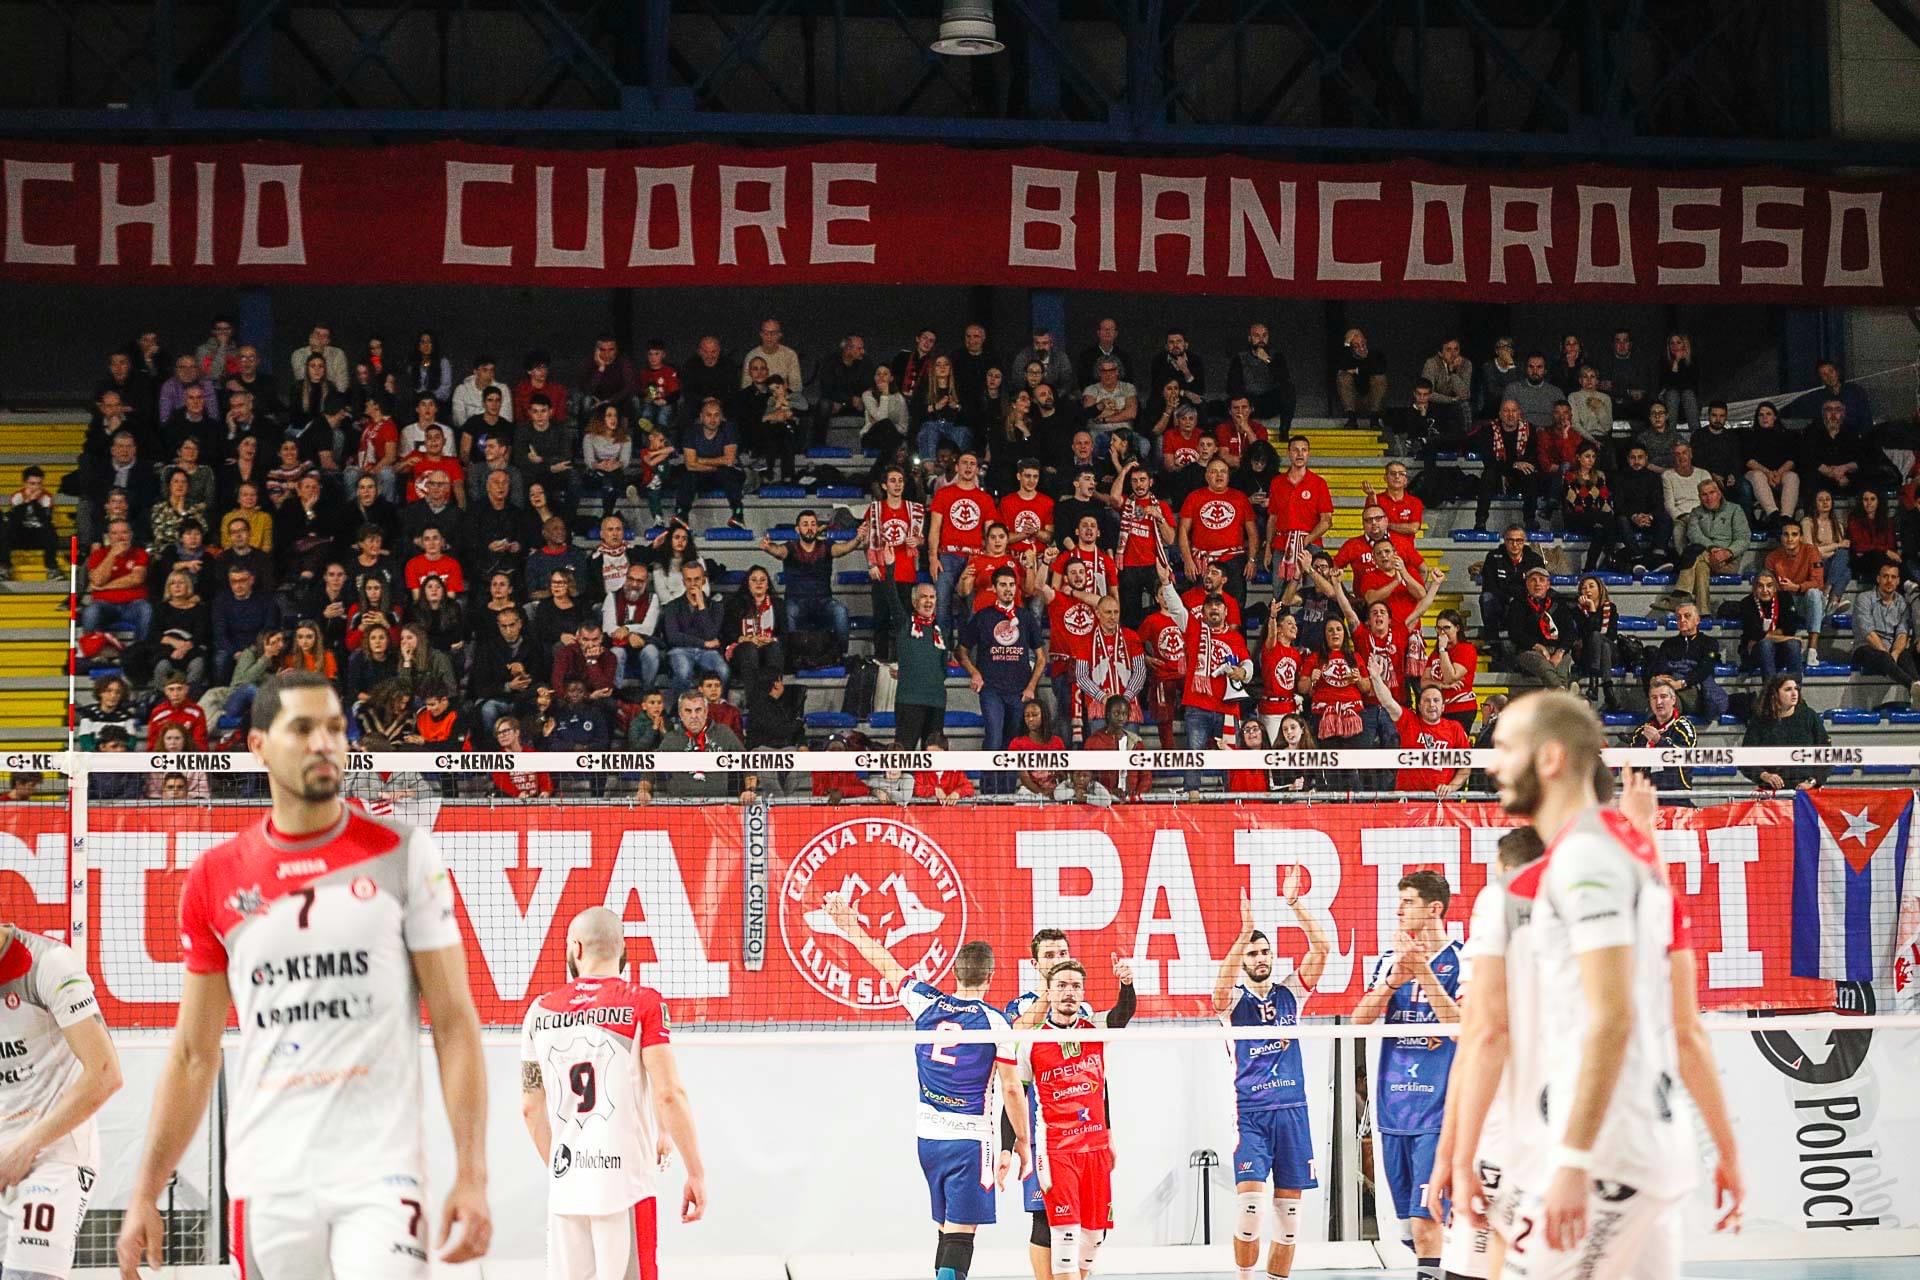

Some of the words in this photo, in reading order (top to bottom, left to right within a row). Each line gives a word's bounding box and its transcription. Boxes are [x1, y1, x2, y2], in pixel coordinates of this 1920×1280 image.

[3, 155, 307, 266] CHIO
[441, 160, 878, 269] CUORE
[1007, 164, 1884, 289] BIANCOROSSO
[176, 754, 230, 770] KEMAS
[459, 754, 515, 770] KEMAS
[601, 754, 655, 770] KEMAS
[741, 753, 795, 769] KEMAS
[879, 753, 932, 768] KEMAS
[1017, 752, 1069, 768] KEMAS
[1152, 752, 1205, 767] KEMAS
[1288, 751, 1339, 767] KEMAS
[1421, 750, 1472, 766] KEMAS
[1684, 748, 1734, 764] KEMAS
[1814, 748, 1863, 763] KEMAS
[749, 805, 764, 857] SOLO
[787, 827, 858, 902] CURVA
[865, 823, 958, 903] PARENTI
[749, 863, 764, 881] IL
[290, 887, 315, 929] 7
[286, 951, 369, 982] KEMAS
[800, 936, 852, 999] LUPI
[534, 1007, 634, 1032] ACQUARONE
[1257, 1000, 1276, 1023] 15
[569, 1061, 596, 1113] 9
[1251, 1079, 1297, 1092] enerklima
[1390, 1081, 1435, 1094] enerklima
[574, 1149, 621, 1170] Polochem
[23, 1202, 55, 1233] 10
